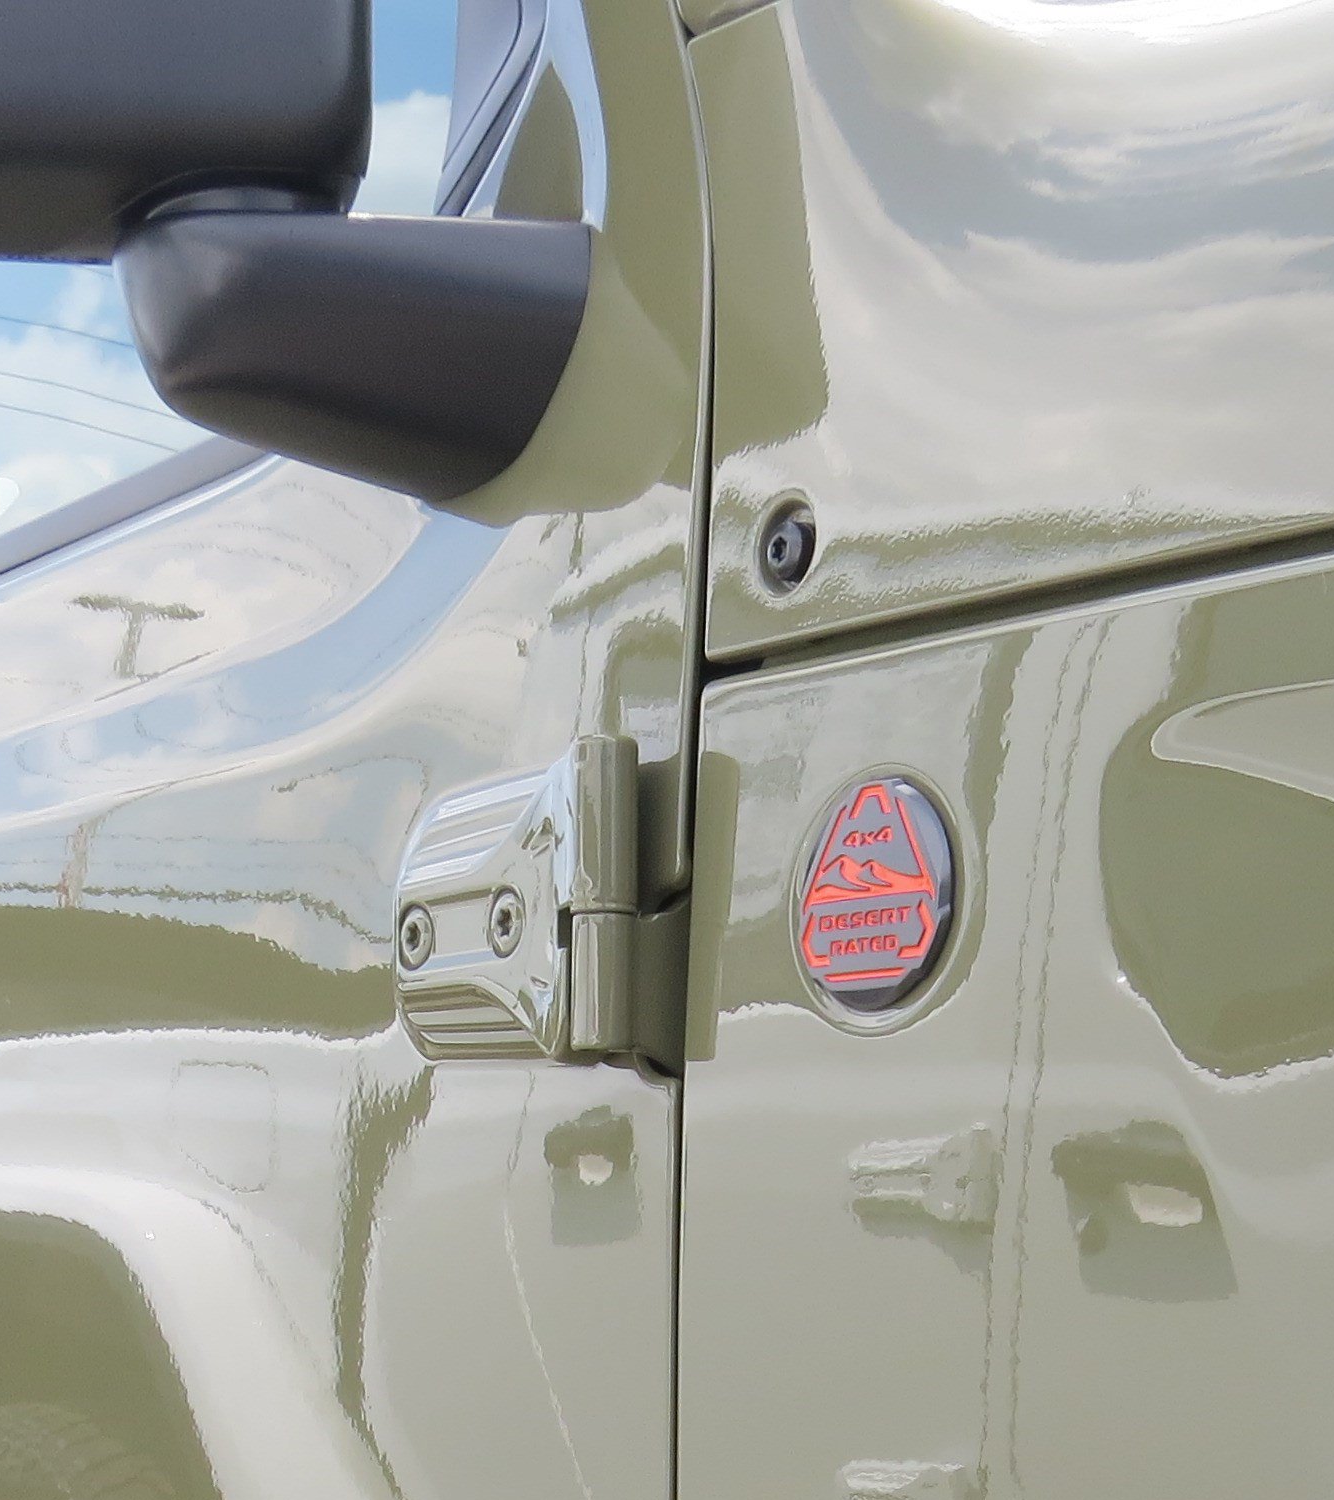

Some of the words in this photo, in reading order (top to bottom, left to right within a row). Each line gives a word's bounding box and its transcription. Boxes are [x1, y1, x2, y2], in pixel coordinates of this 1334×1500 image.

[842, 826, 894, 848] 4x4
[819, 906, 911, 932] DESERT
[829, 935, 899, 957] RATED
